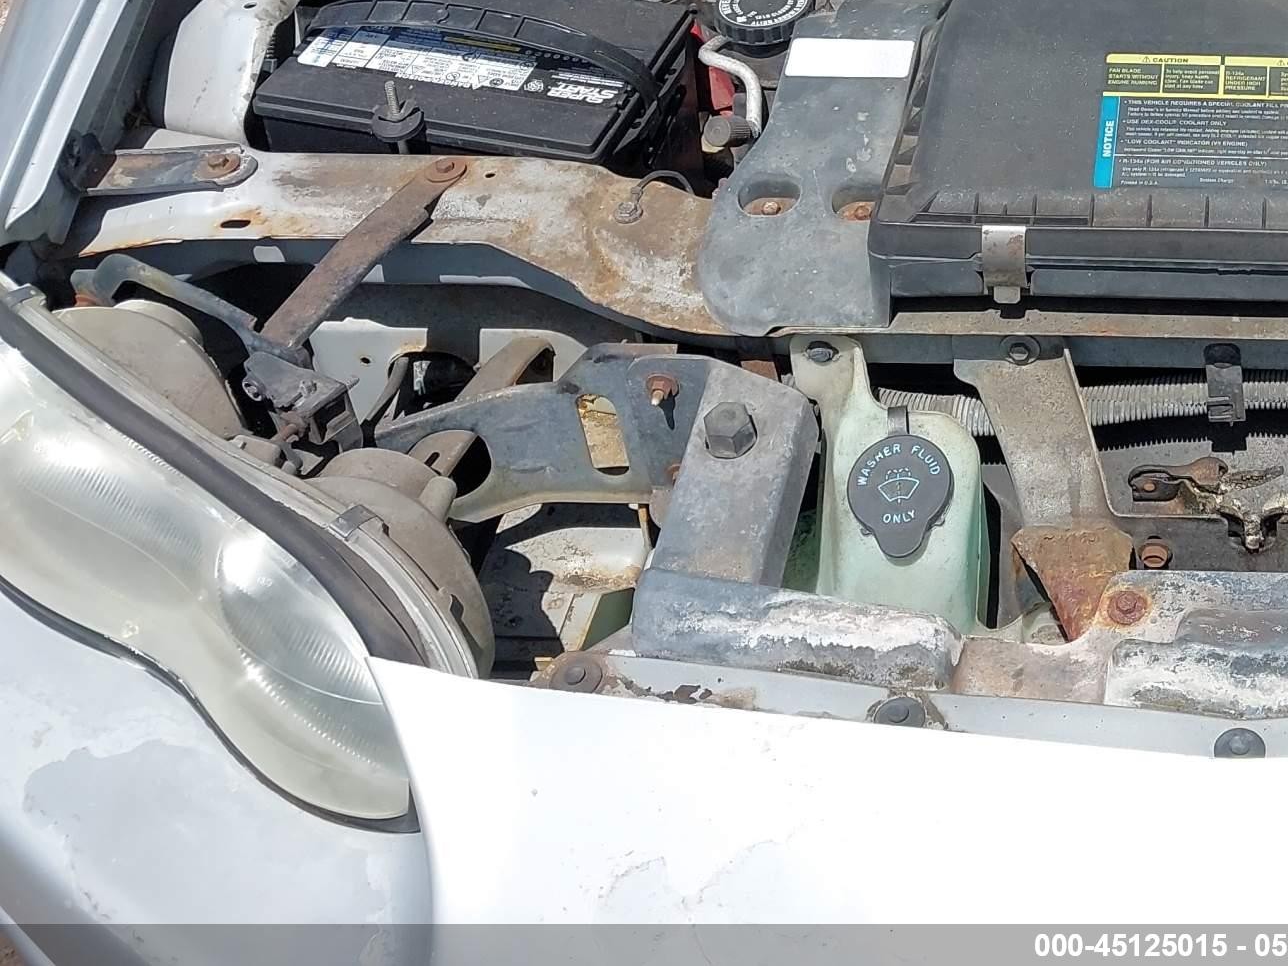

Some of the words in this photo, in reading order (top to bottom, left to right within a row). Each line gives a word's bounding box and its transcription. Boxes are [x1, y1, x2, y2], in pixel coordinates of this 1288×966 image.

[547, 87, 603, 103] SUPER
[558, 82, 618, 98] START
[1102, 120, 1115, 157] NOTICE
[857, 443, 901, 486] WASHER
[911, 445, 941, 475] FLUID
[883, 509, 915, 523] ONLY
